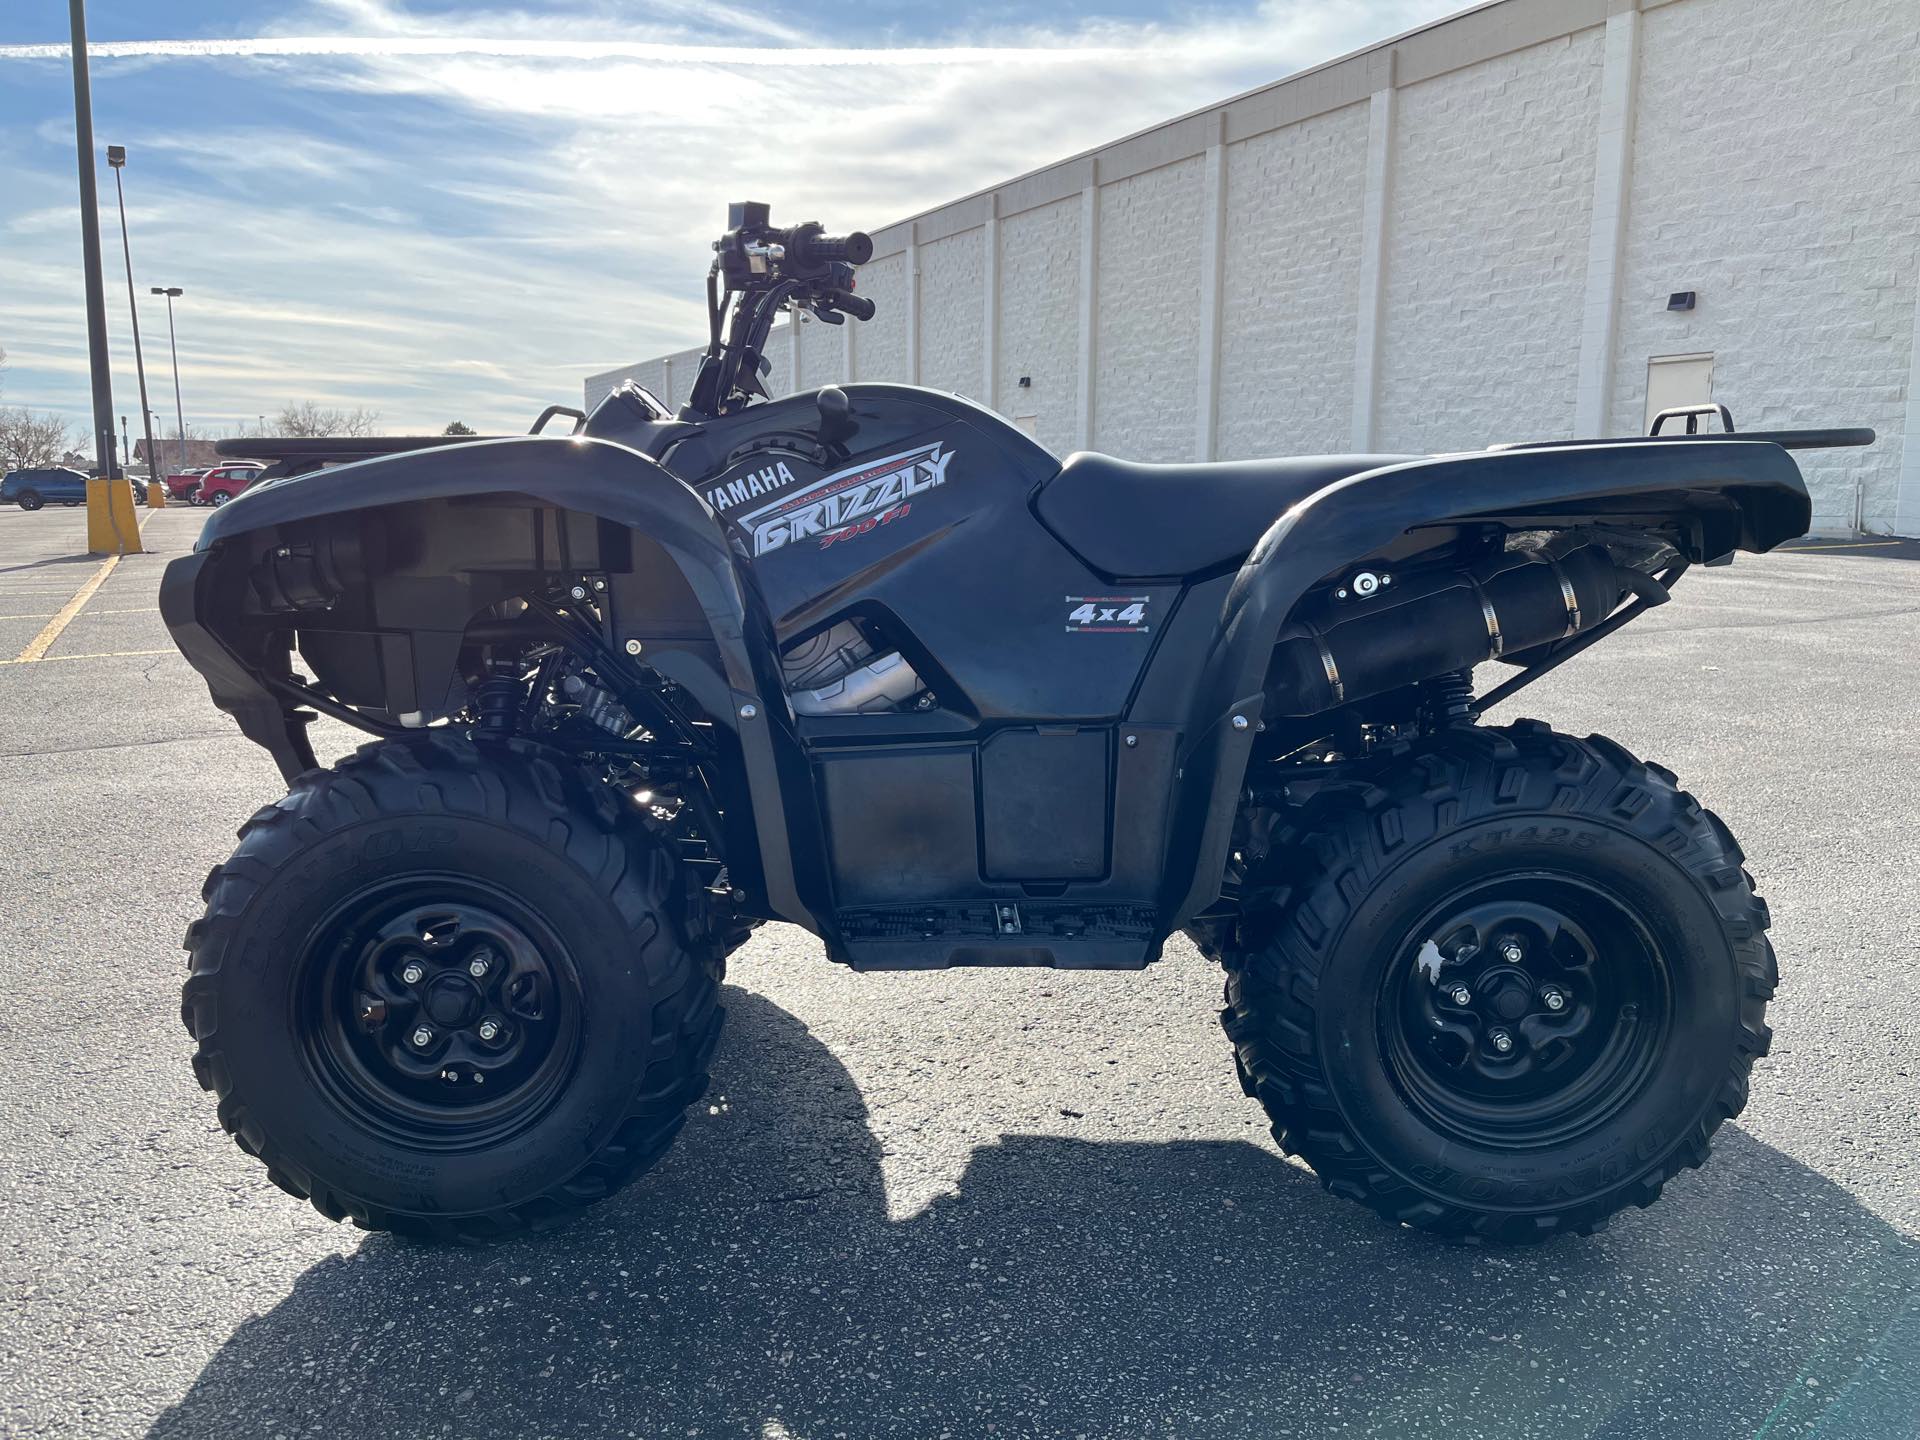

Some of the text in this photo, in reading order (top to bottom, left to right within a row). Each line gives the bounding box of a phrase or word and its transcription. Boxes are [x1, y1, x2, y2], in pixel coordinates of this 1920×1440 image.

[754, 450, 956, 558] GRIZZLY
[820, 503, 912, 550] 700 FI
[1068, 603, 1146, 625] 4x4
